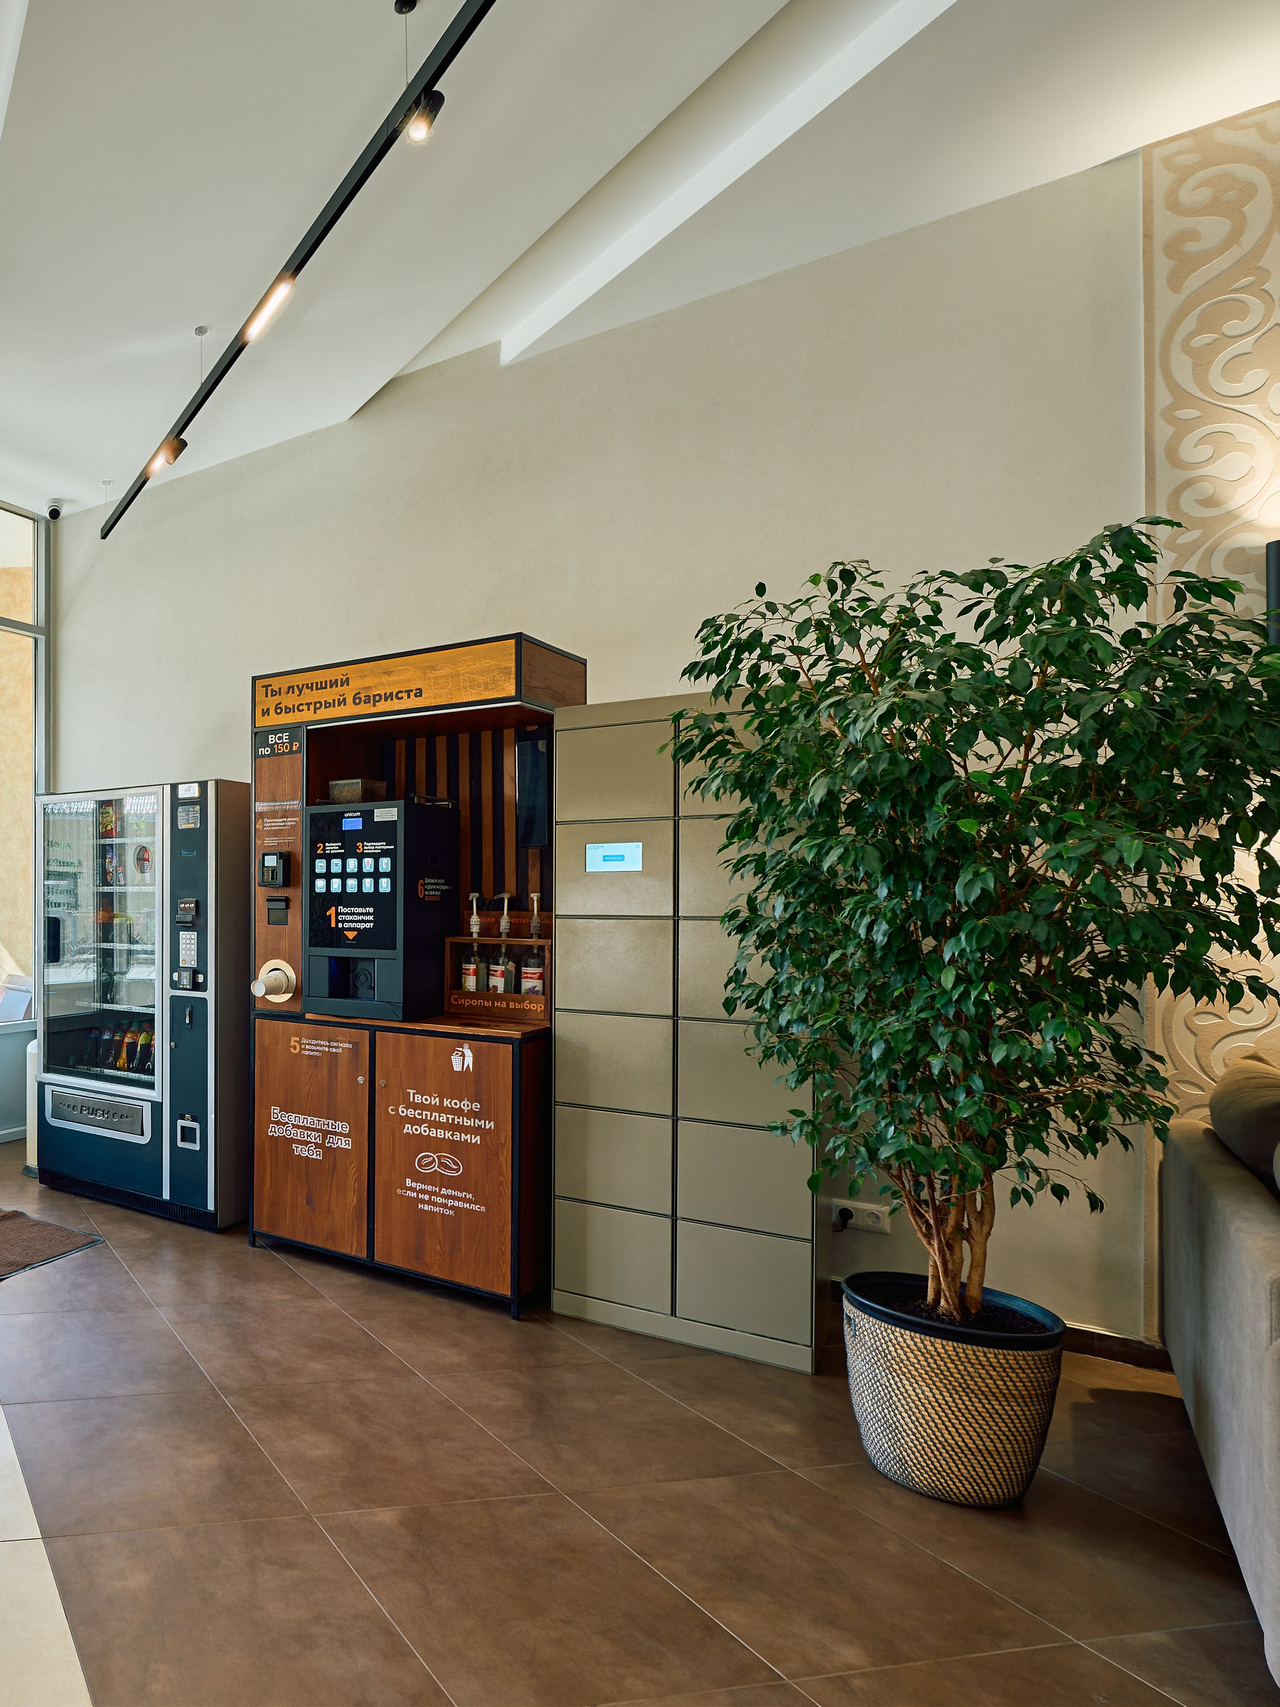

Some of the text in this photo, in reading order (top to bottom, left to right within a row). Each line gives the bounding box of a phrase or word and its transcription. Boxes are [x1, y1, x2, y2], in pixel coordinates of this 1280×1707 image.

[261, 673, 350, 698] Ты лучший
[261, 687, 423, 717] и быстрый бариста
[268, 733, 290, 745] ВСЕ
[258, 747, 270, 756] по
[273, 743, 290, 754] 150
[256, 818, 263, 830] 4
[317, 843, 324, 854] 2
[356, 842, 363, 853] 3
[418, 879, 424, 898] 6
[326, 906, 336, 927] 1
[450, 995, 492, 1007] Сиропы
[509, 1000, 545, 1012] выбор
[290, 1036, 300, 1054] 5
[301, 1037, 353, 1049] Дождитесь сигнала
[306, 1044, 328, 1052] возьмите
[407, 1089, 481, 1113] Твой кофе
[80, 1104, 110, 1120] PUSH
[271, 1106, 350, 1134] Бесплатные
[388, 1104, 494, 1130] с бесплатными
[268, 1123, 352, 1149] добавки для
[403, 1123, 480, 1145] добавками
[292, 1143, 323, 1160] тебя
[405, 1177, 475, 1201] Вернем деньги,
[396, 1188, 486, 1212] если не понравился
[418, 1203, 455, 1216] напиток
